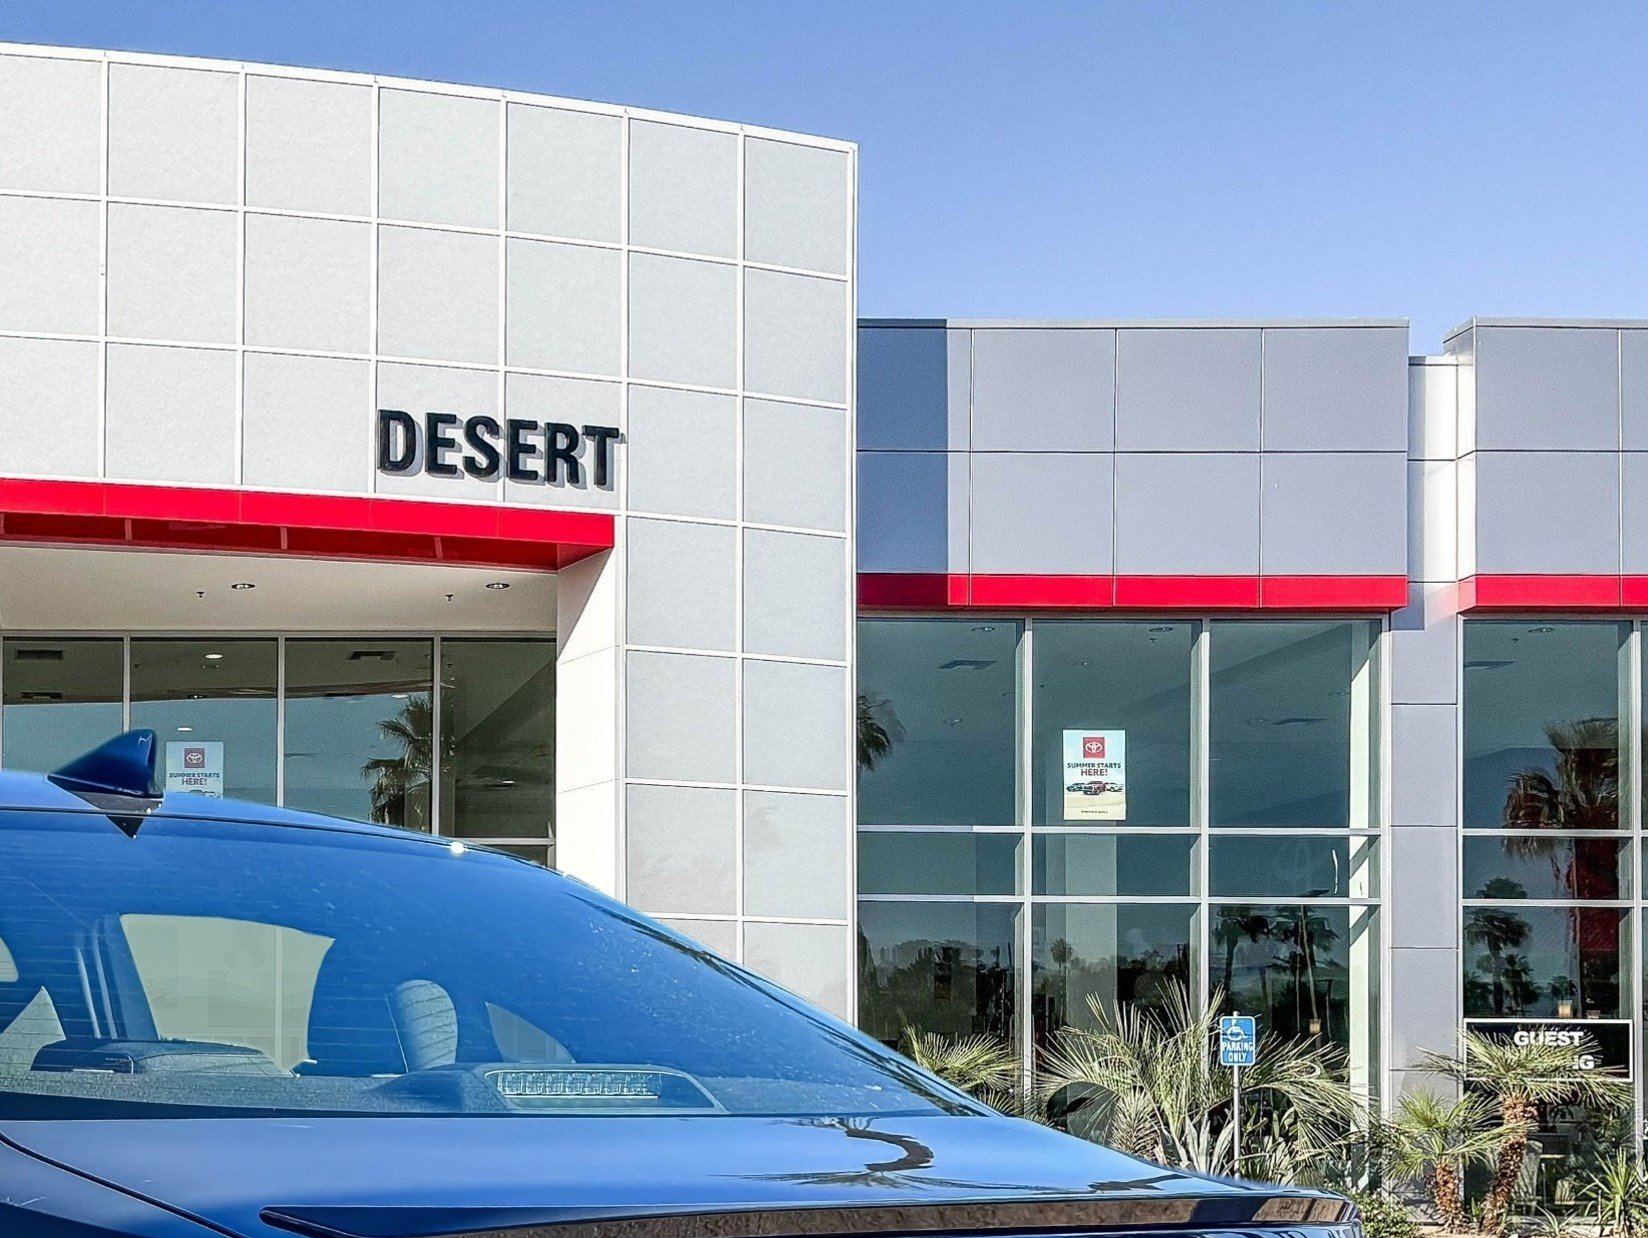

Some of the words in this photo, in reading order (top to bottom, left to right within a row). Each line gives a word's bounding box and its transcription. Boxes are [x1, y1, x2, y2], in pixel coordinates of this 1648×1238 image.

[377, 409, 620, 487] DESERT
[1080, 768, 1108, 776] HERE!
[1513, 1030, 1584, 1047] GUEST
[1222, 1041, 1253, 1051] PARKING
[1228, 1052, 1247, 1062] ONLY
